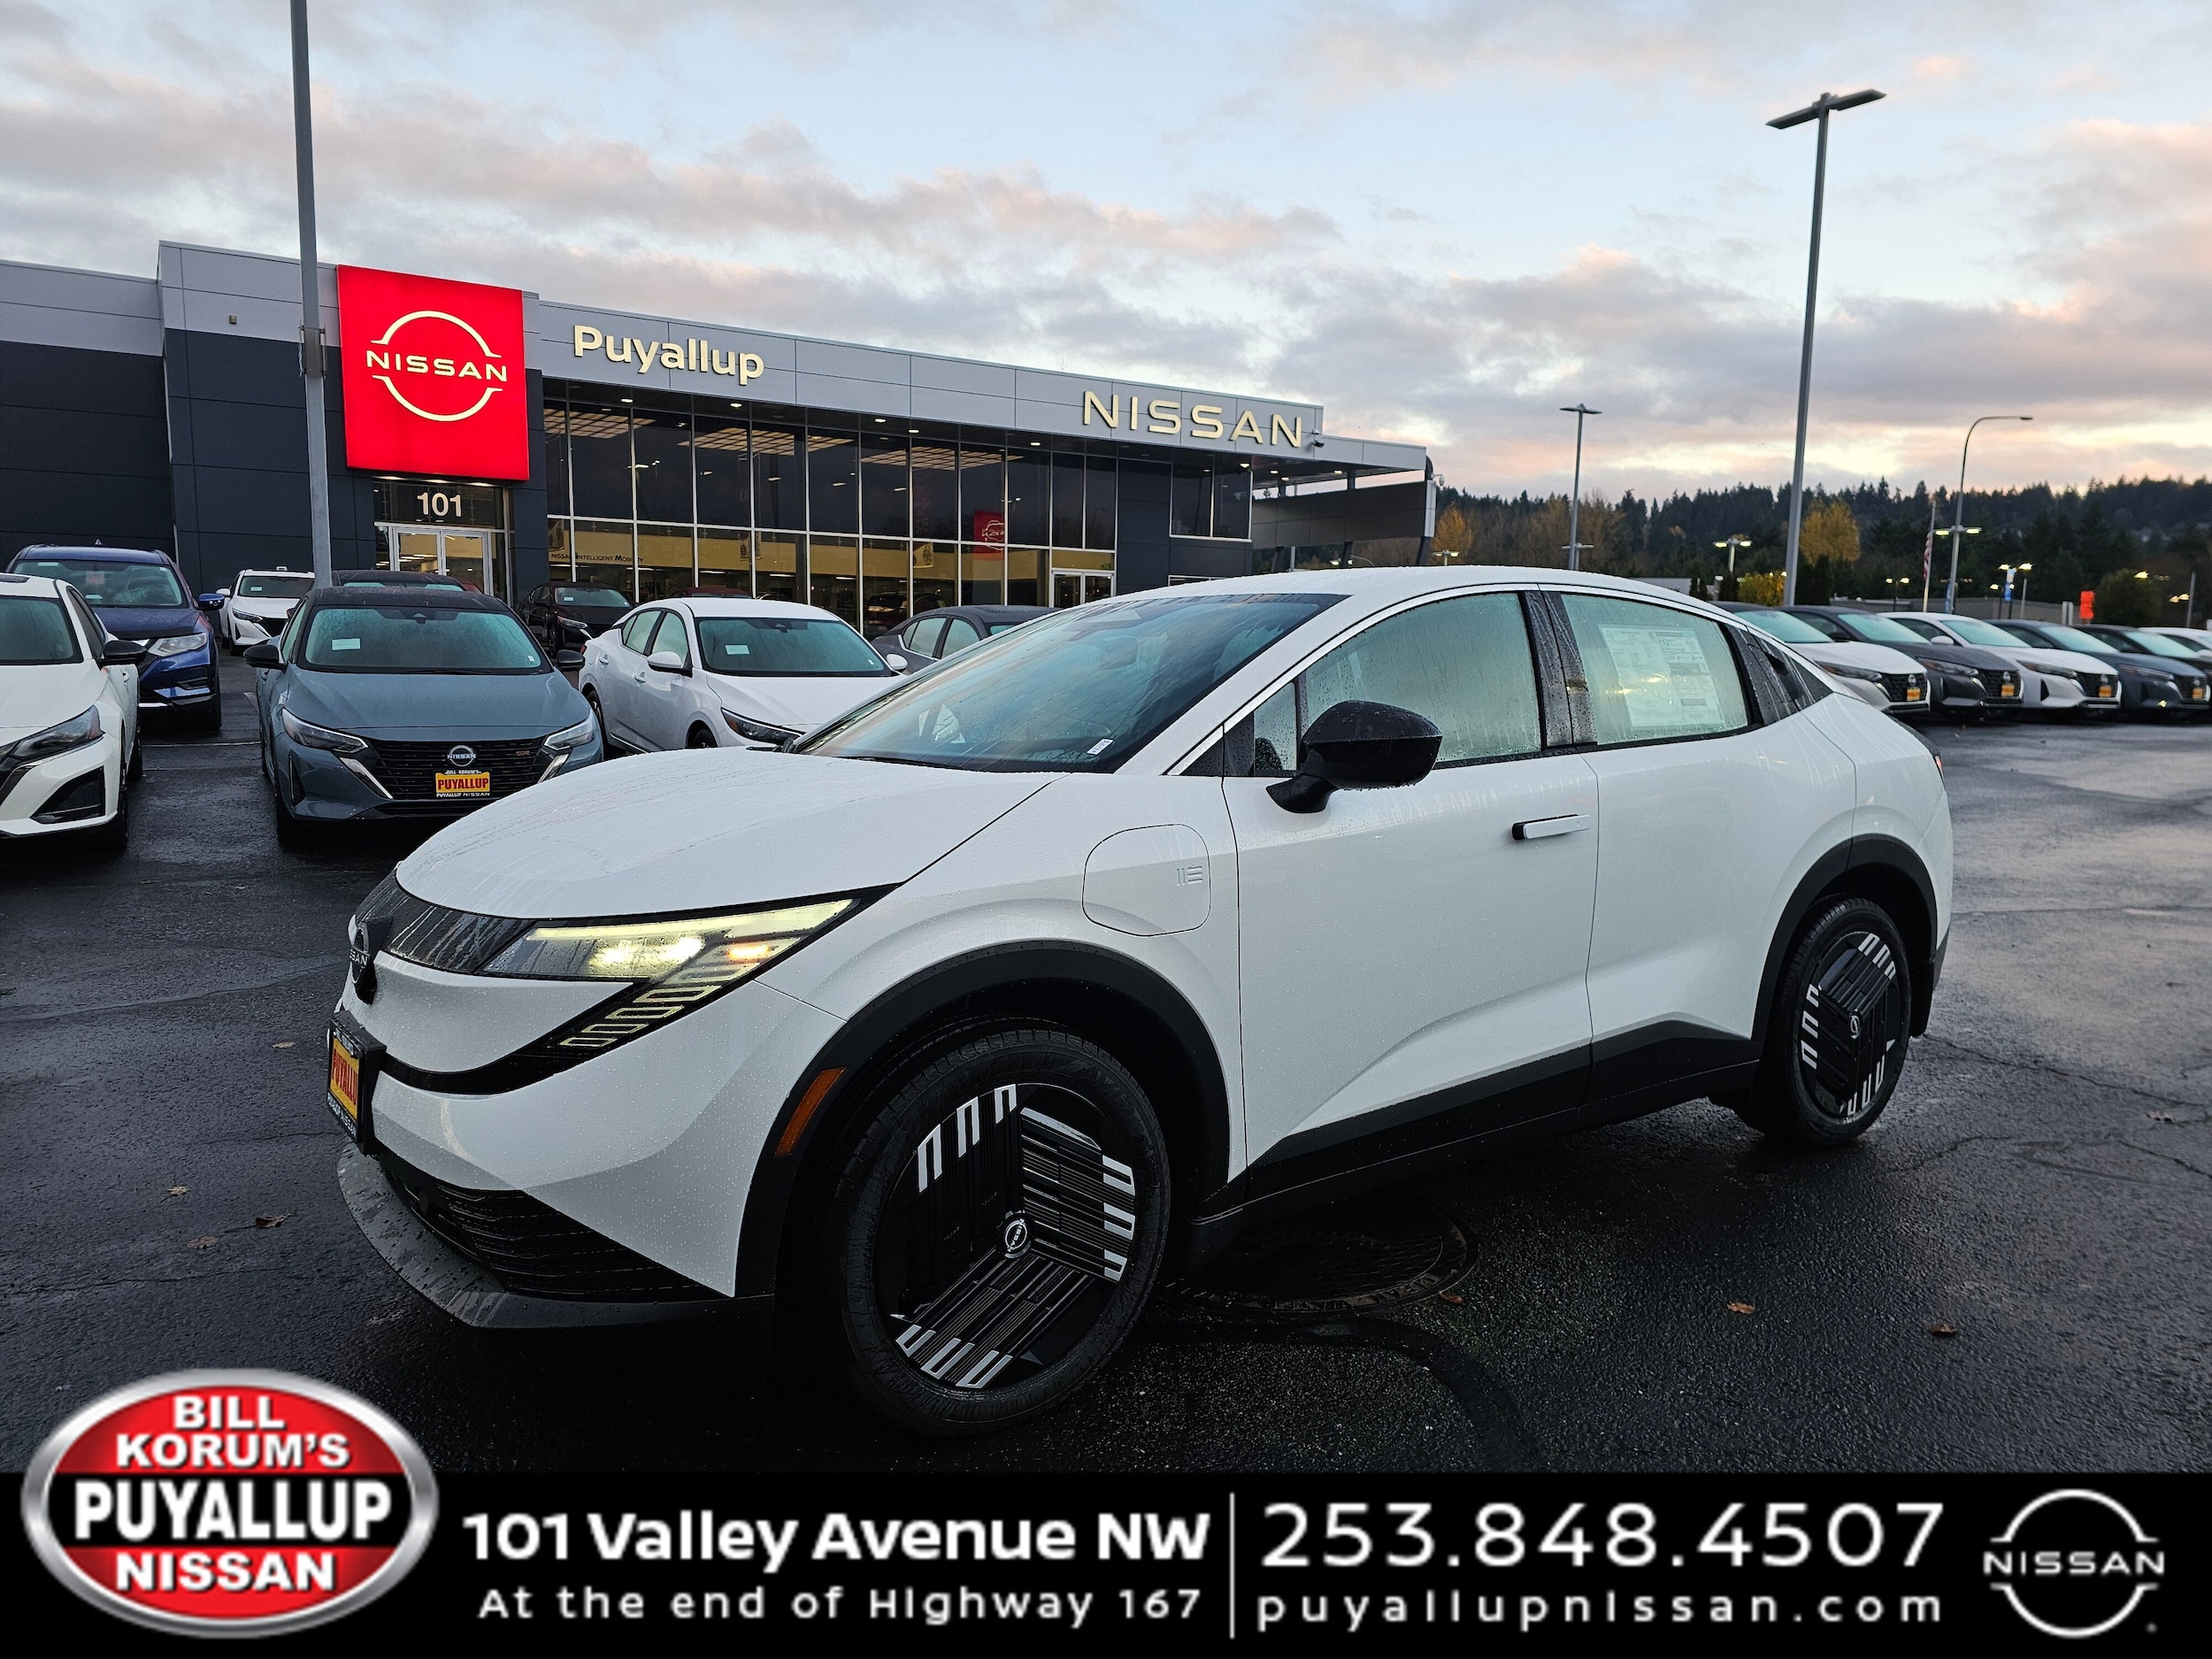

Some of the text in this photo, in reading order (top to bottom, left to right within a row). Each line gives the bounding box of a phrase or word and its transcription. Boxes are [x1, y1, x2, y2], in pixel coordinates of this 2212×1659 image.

[365, 350, 507, 382] NISSAN
[573, 324, 764, 386] Puyallup
[1083, 390, 1302, 449] NISSAN
[417, 492, 463, 518] 101
[437, 779, 488, 789] PUYALLUP
